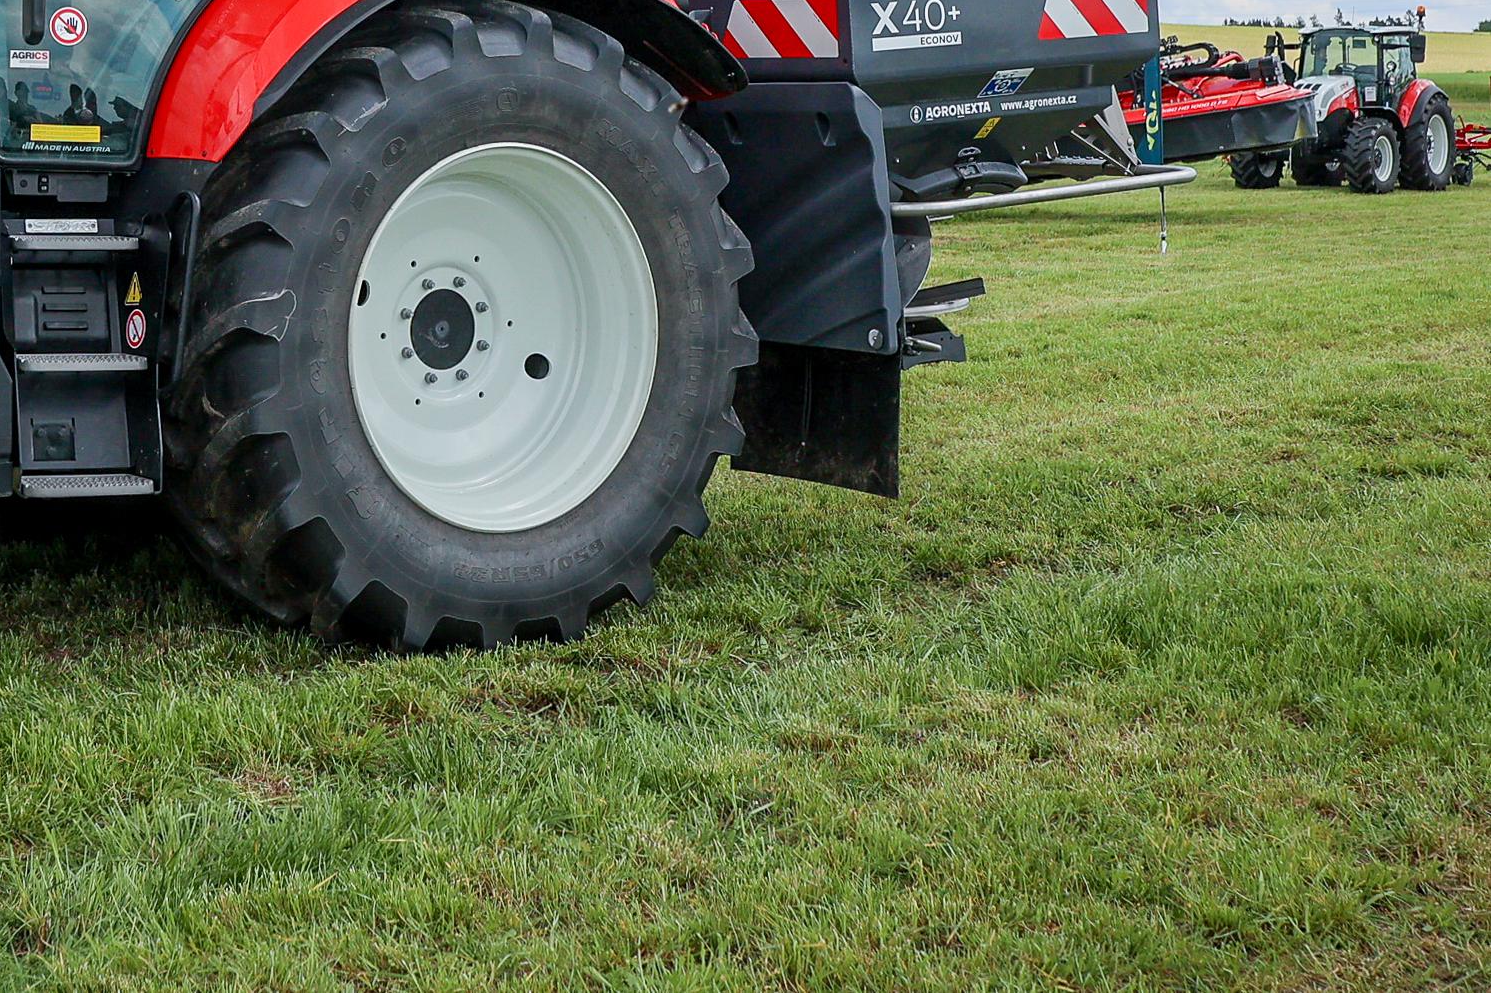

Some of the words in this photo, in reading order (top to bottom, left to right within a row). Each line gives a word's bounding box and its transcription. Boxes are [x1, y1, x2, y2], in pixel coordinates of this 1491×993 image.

[920, 34, 960, 45] ECONOV
[11, 51, 48, 60] AGRICS
[925, 101, 992, 121] AGRONEXTA
[1000, 95, 1078, 111] www.agronexta.cz
[74, 145, 111, 153] AUSTRIA
